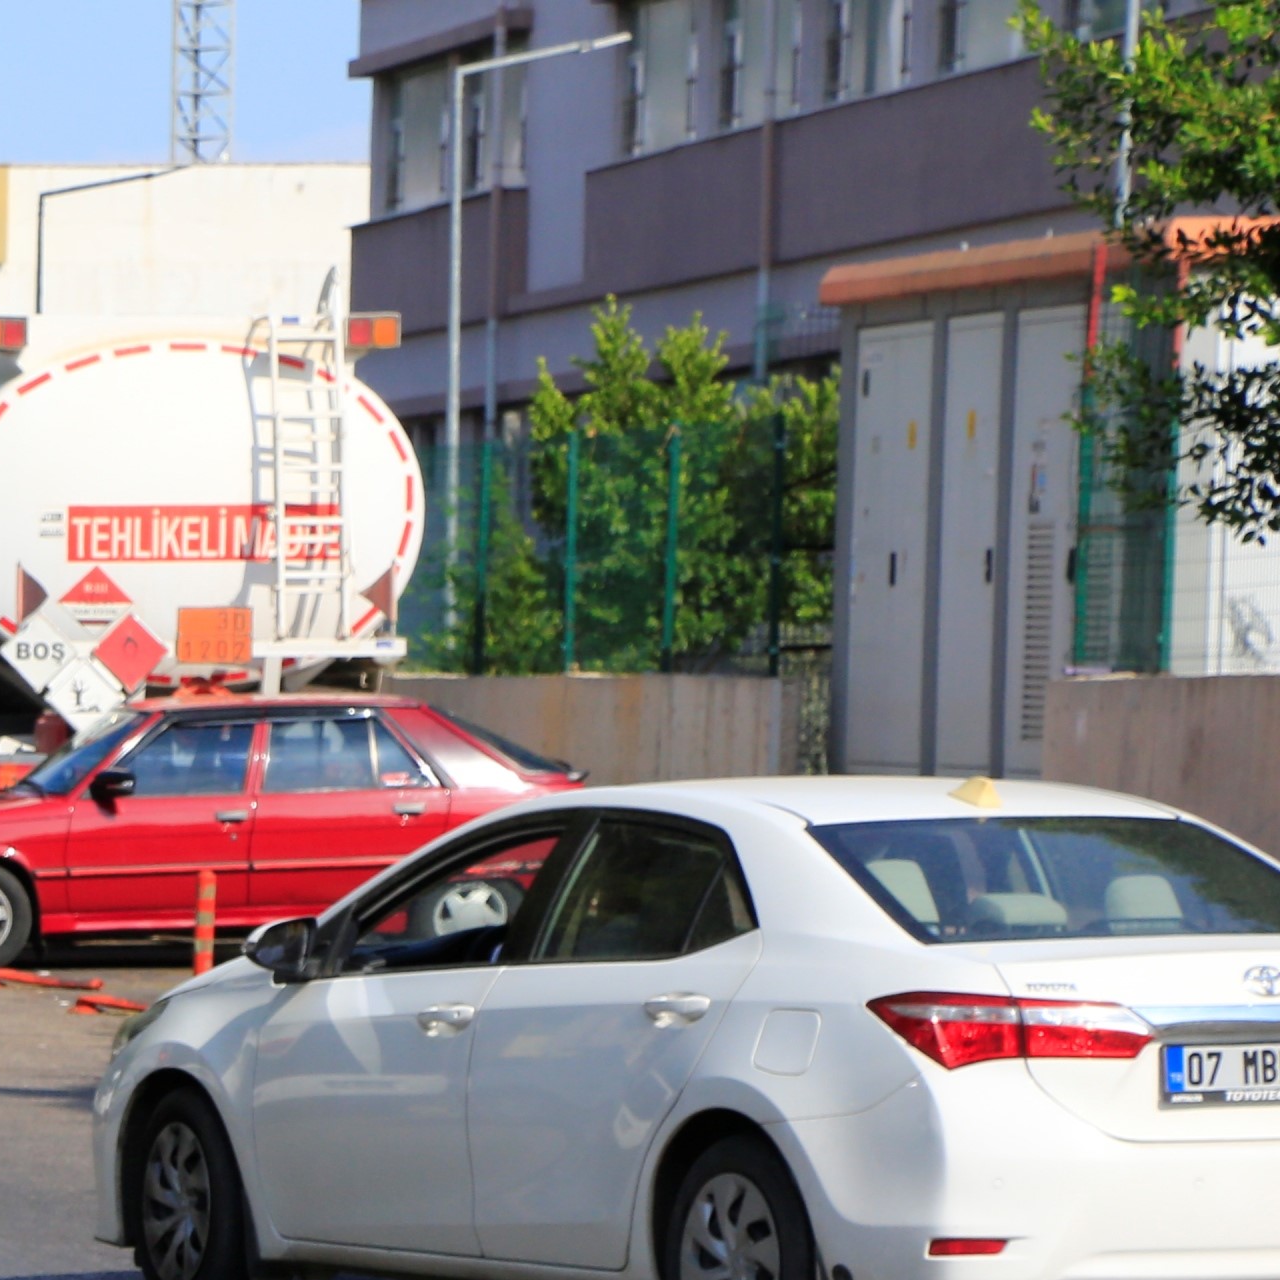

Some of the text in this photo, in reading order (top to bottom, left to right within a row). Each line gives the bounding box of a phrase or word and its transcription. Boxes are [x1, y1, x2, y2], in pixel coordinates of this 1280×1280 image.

[70, 509, 229, 559] TEHLİKELİ
[16, 641, 65, 665] BOŞ
[185, 640, 244, 660] 1202
[1026, 982, 1078, 993] TOYOTA
[1188, 1052, 1223, 1086] 07
